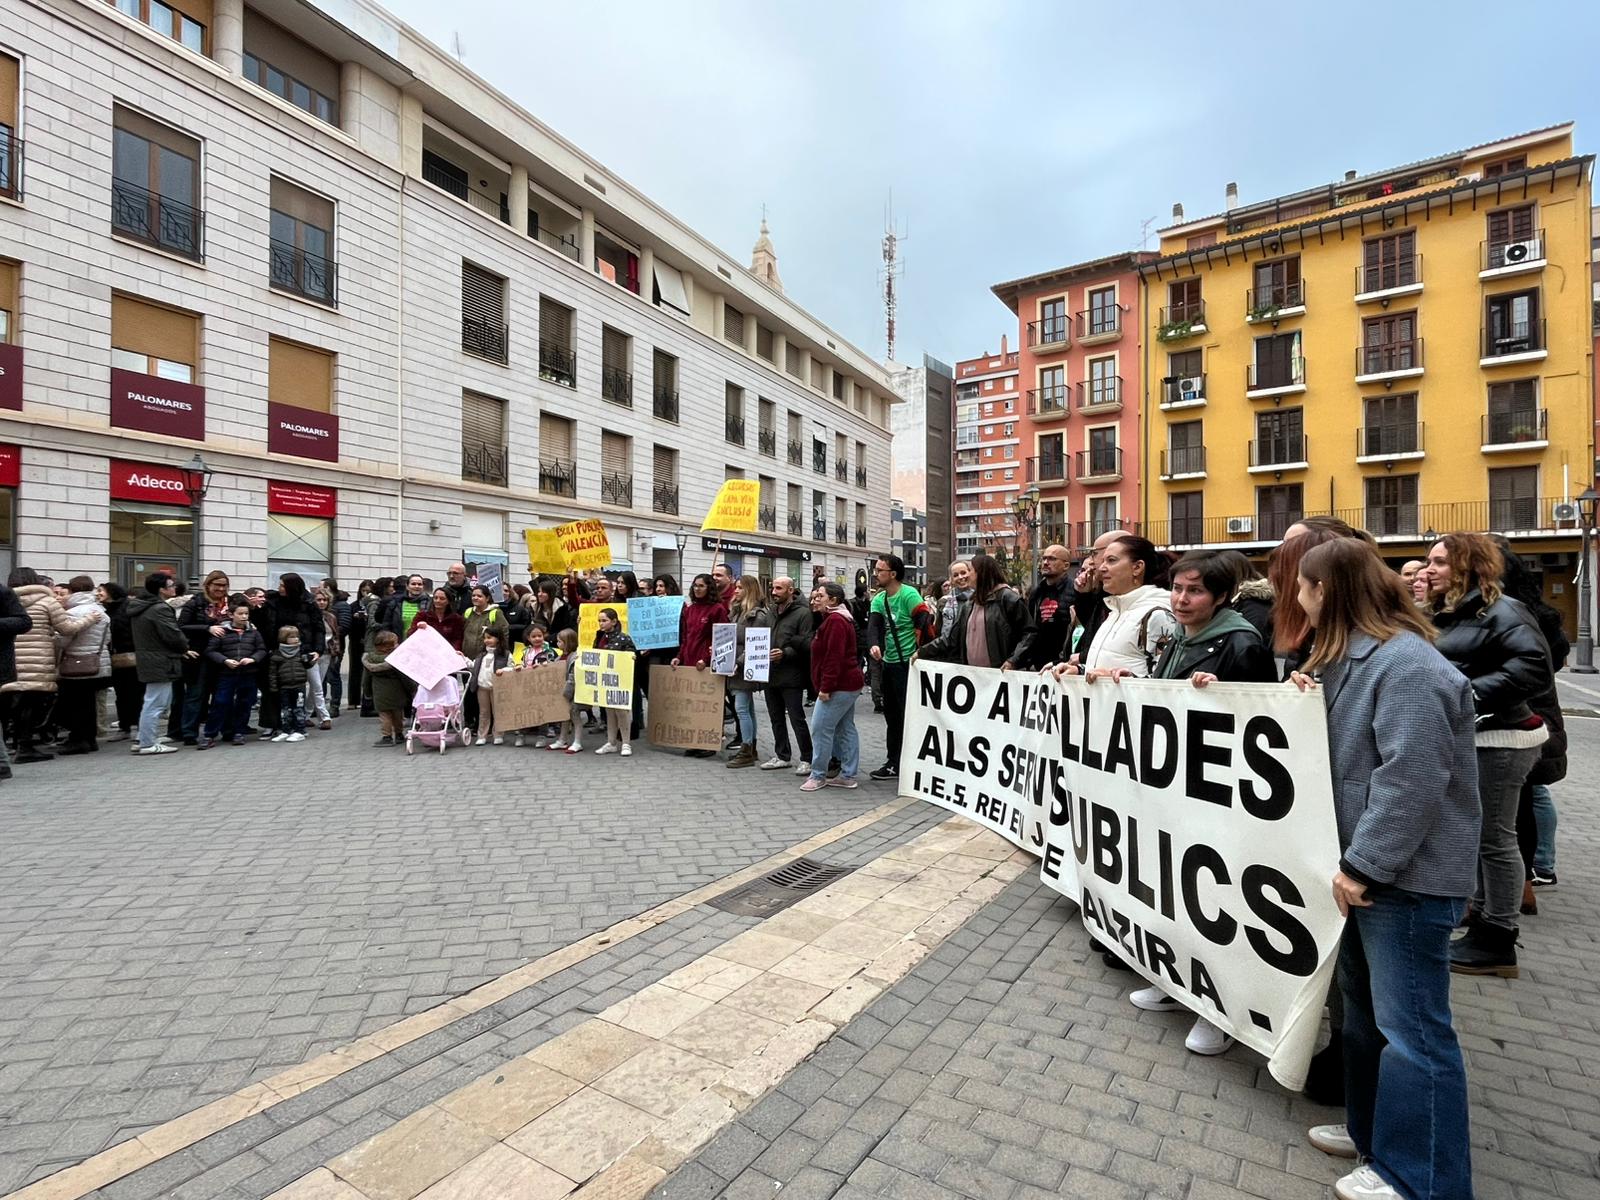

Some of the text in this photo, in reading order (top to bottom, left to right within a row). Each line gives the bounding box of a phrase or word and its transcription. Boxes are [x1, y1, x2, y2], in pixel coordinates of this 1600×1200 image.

[127, 391, 192, 411] PALOMARES
[280, 421, 329, 437] PALOMARES
[127, 473, 184, 491] Adecco
[919, 670, 976, 715] NO
[987, 681, 1010, 724] A
[1019, 683, 1048, 732] LES
[917, 724, 991, 778] ALS
[1066, 789, 1319, 977] UBLICS
[913, 771, 968, 809] I.E.S.
[975, 791, 1007, 826] REI
[1082, 886, 1228, 1018] ALZIRA
